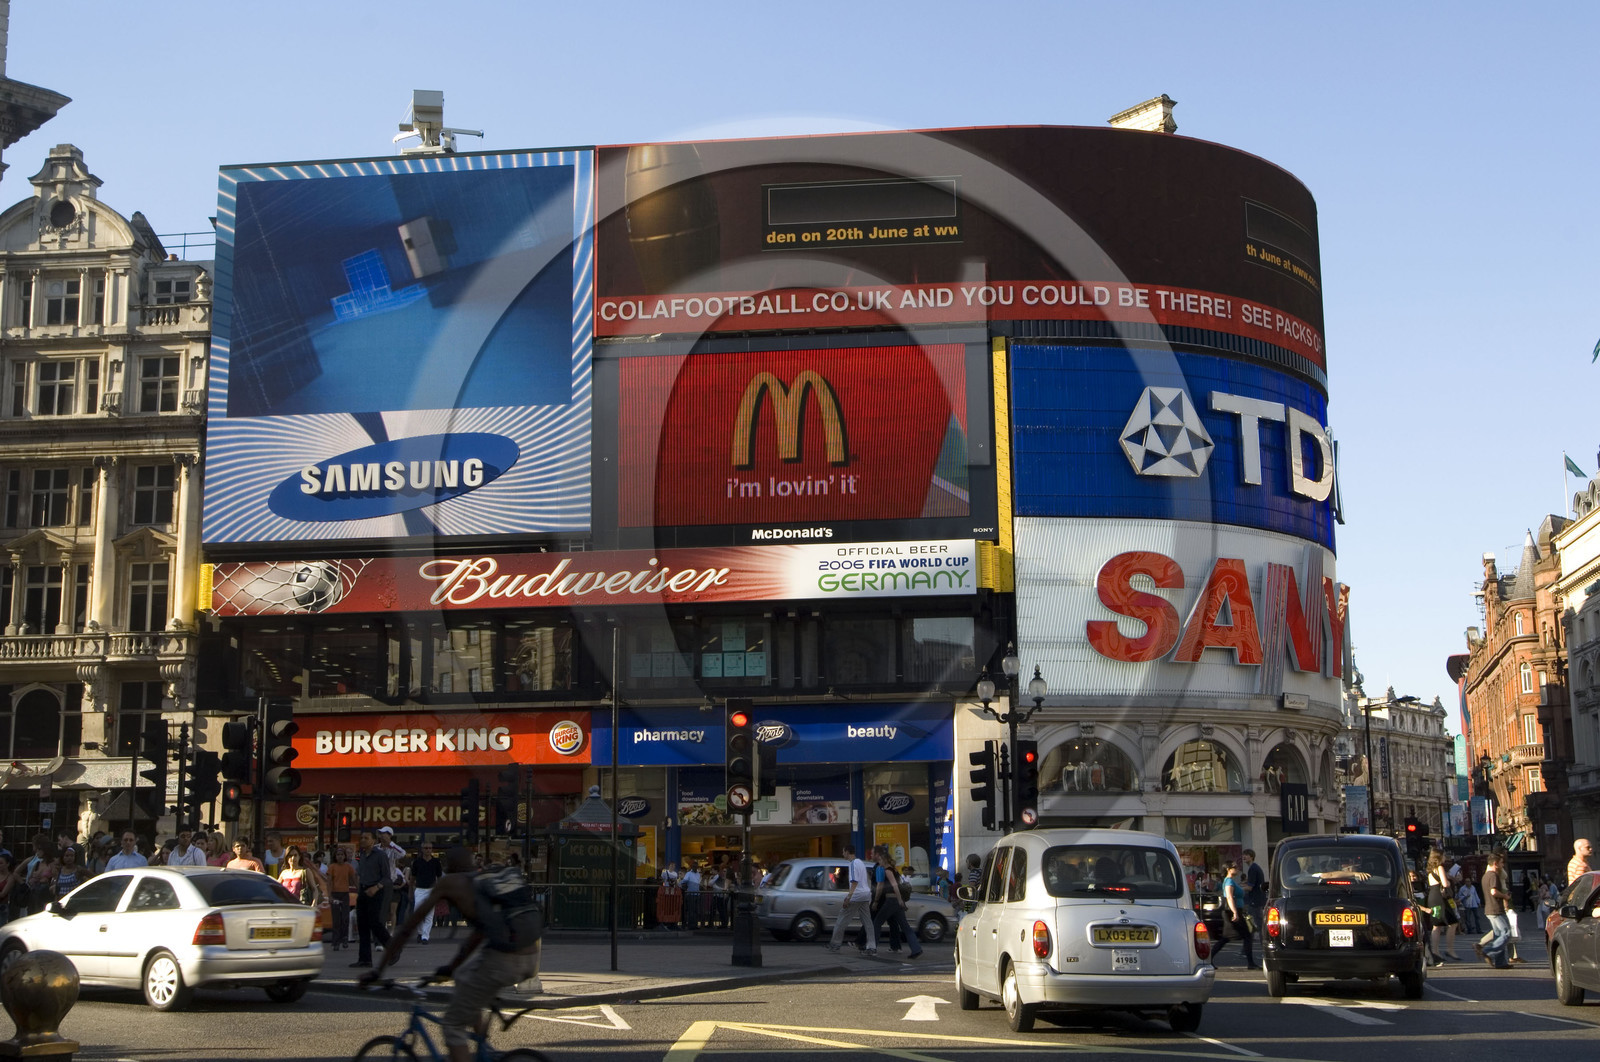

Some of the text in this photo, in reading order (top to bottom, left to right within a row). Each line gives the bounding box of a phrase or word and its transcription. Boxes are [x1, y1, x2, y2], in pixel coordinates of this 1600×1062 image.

[766, 231, 796, 244] den
[801, 231, 821, 242] on
[826, 227, 864, 241] 20th
[869, 226, 909, 239] June
[913, 225, 930, 237] at
[1259, 248, 1281, 266] June
[597, 289, 893, 321] COLAFOOTBALL.CO.UK
[899, 287, 954, 311] AND
[960, 285, 1013, 306] YOU
[1022, 285, 1110, 307] COULD
[1118, 287, 1150, 309] BE
[1155, 290, 1232, 319] THERE!
[1241, 303, 1272, 330] SEE
[1275, 311, 1313, 347] PACKS
[1208, 390, 1343, 523] TD
[300, 458, 484, 494] SAMSUNG
[727, 474, 857, 498] i'm lovin' it
[752, 527, 833, 540] McDonald's
[837, 545, 948, 557] OFFICIAL BEER
[819, 557, 969, 571] 2006 FIFA WORLD CUP
[419, 557, 730, 605] Budweiser
[818, 569, 969, 593] GERMANY
[316, 727, 510, 754] BURGER KING
[555, 727, 578, 739] BURGER
[556, 732, 579, 746] KING
[633, 727, 705, 744] pharmacy
[755, 725, 785, 742] Boots
[847, 725, 897, 740] beauty
[618, 799, 646, 815] Boots
[881, 795, 910, 811] Boots
[1287, 794, 1305, 822] GAP
[345, 805, 426, 822] BURGER
[1193, 823, 1207, 837] GAP
[569, 844, 585, 856] ICE
[1318, 914, 1362, 923] LS06 GPU
[1098, 930, 1150, 941] LX03 EZZ
[1115, 956, 1138, 964] 41985
